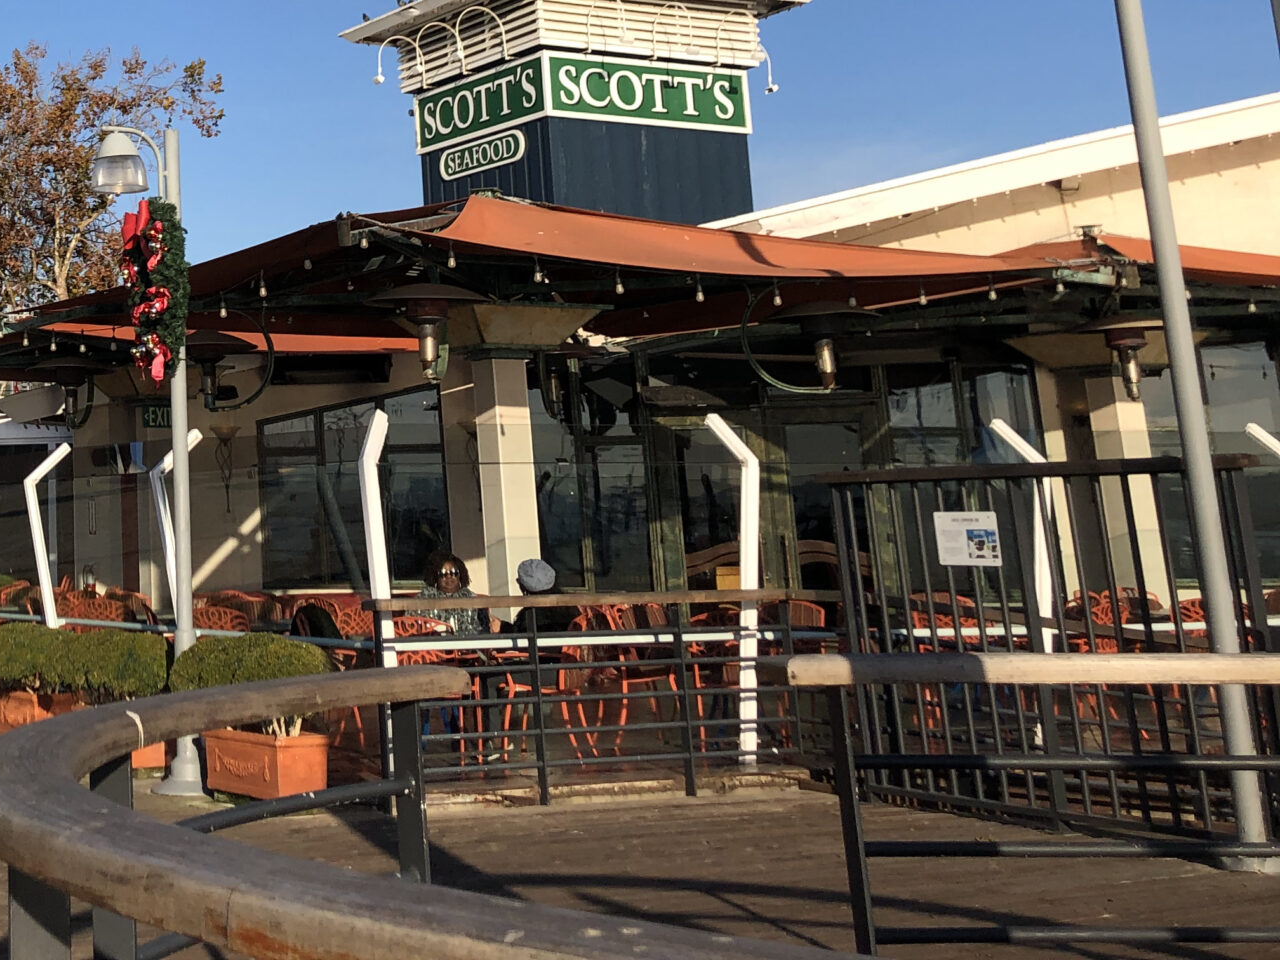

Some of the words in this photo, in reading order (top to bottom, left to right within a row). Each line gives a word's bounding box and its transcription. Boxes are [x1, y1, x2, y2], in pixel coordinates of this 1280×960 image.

[423, 65, 537, 139] SCOTT'S
[558, 65, 735, 120] SCOTT'S
[447, 136, 515, 174] SEAFOOD
